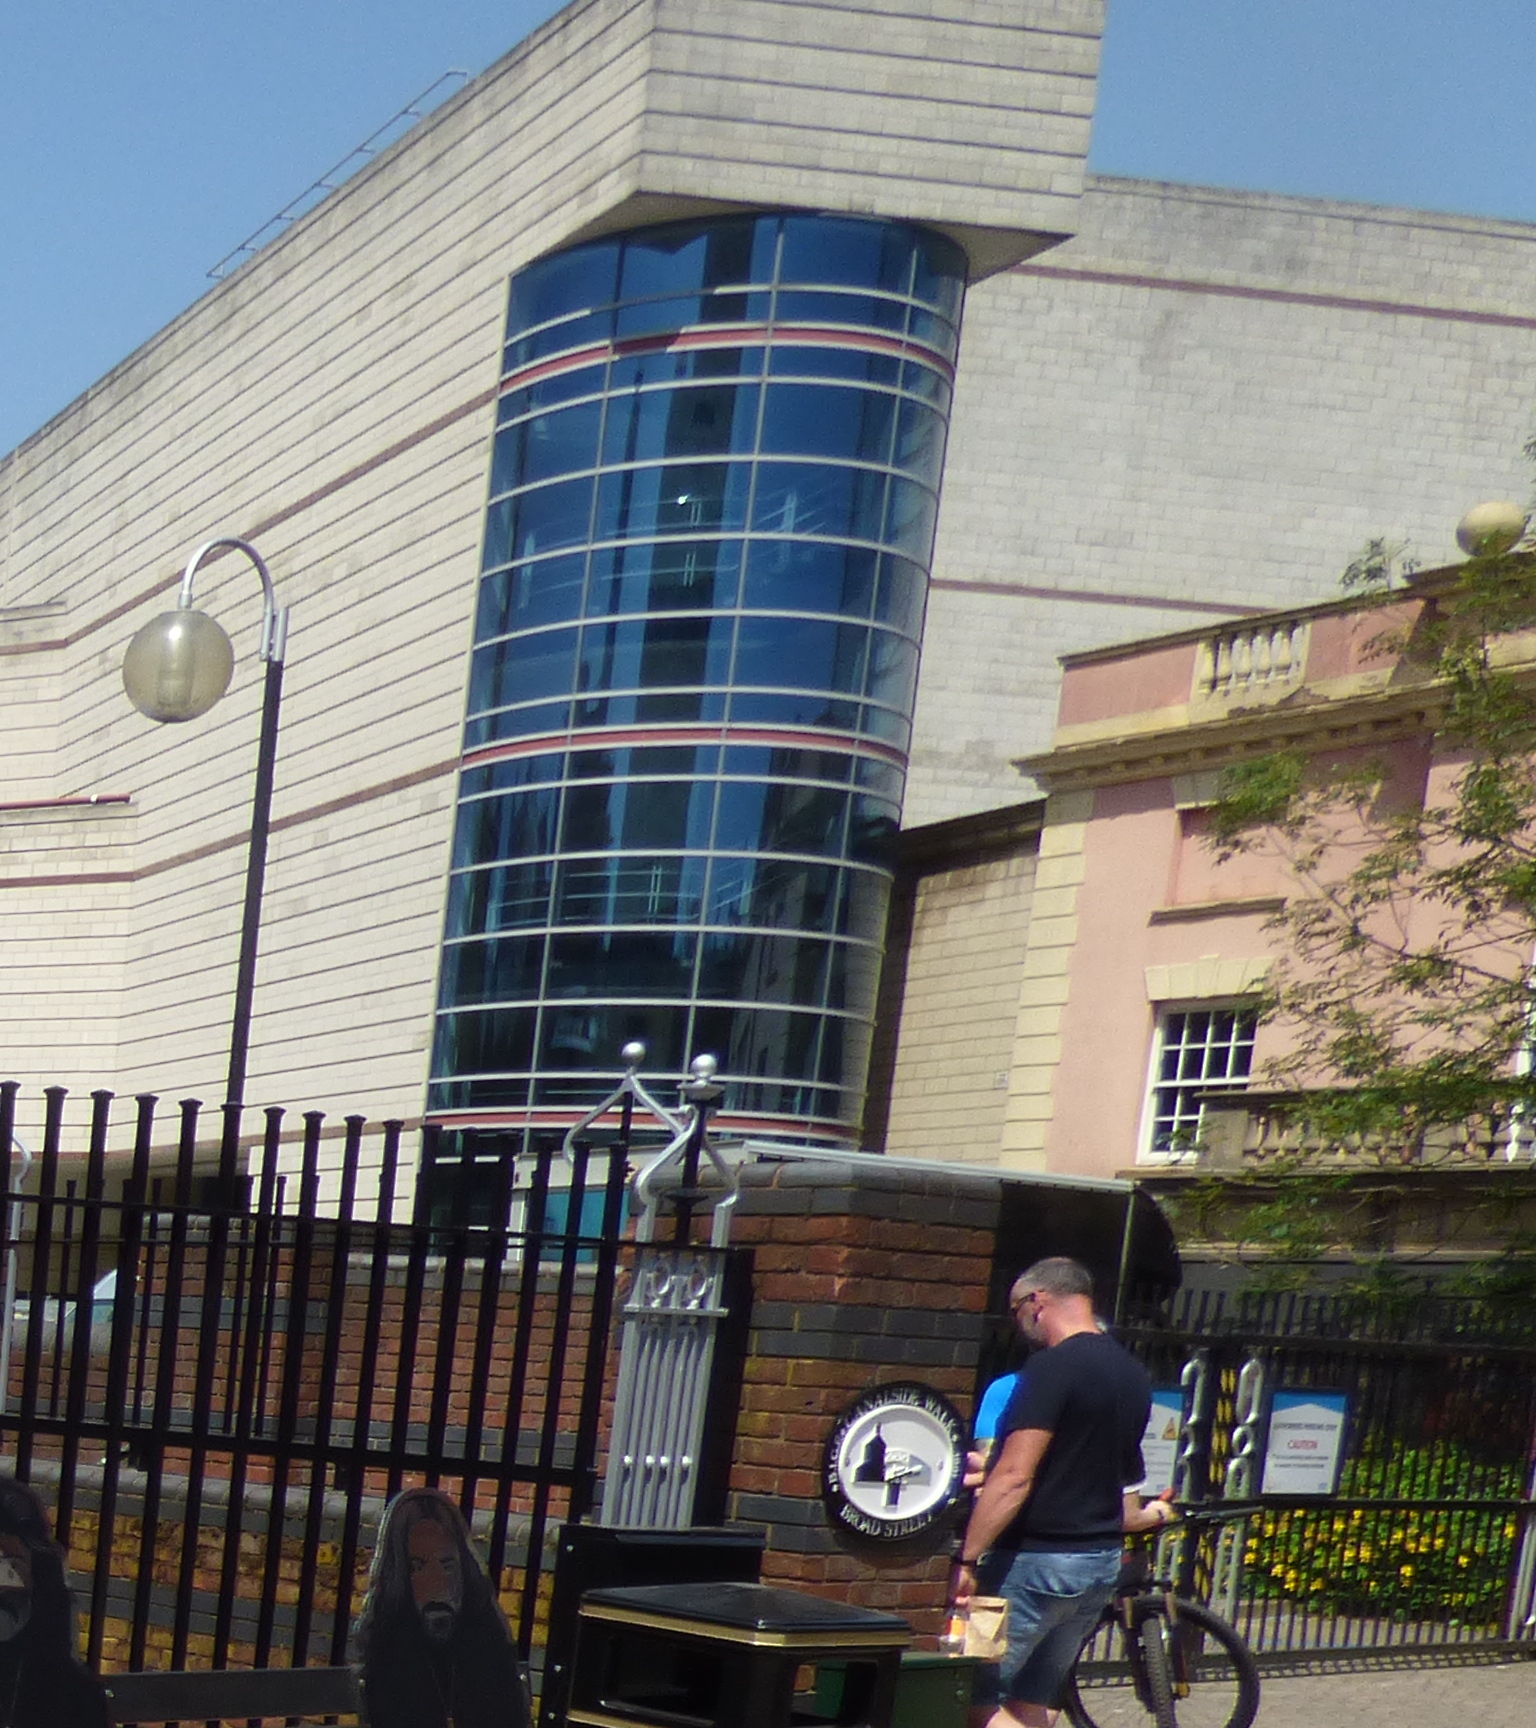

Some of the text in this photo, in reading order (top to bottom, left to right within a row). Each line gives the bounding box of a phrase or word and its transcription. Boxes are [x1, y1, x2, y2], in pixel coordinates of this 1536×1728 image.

[924, 1395, 957, 1434] WALK
[839, 1503, 934, 1539] BROAD STREET
